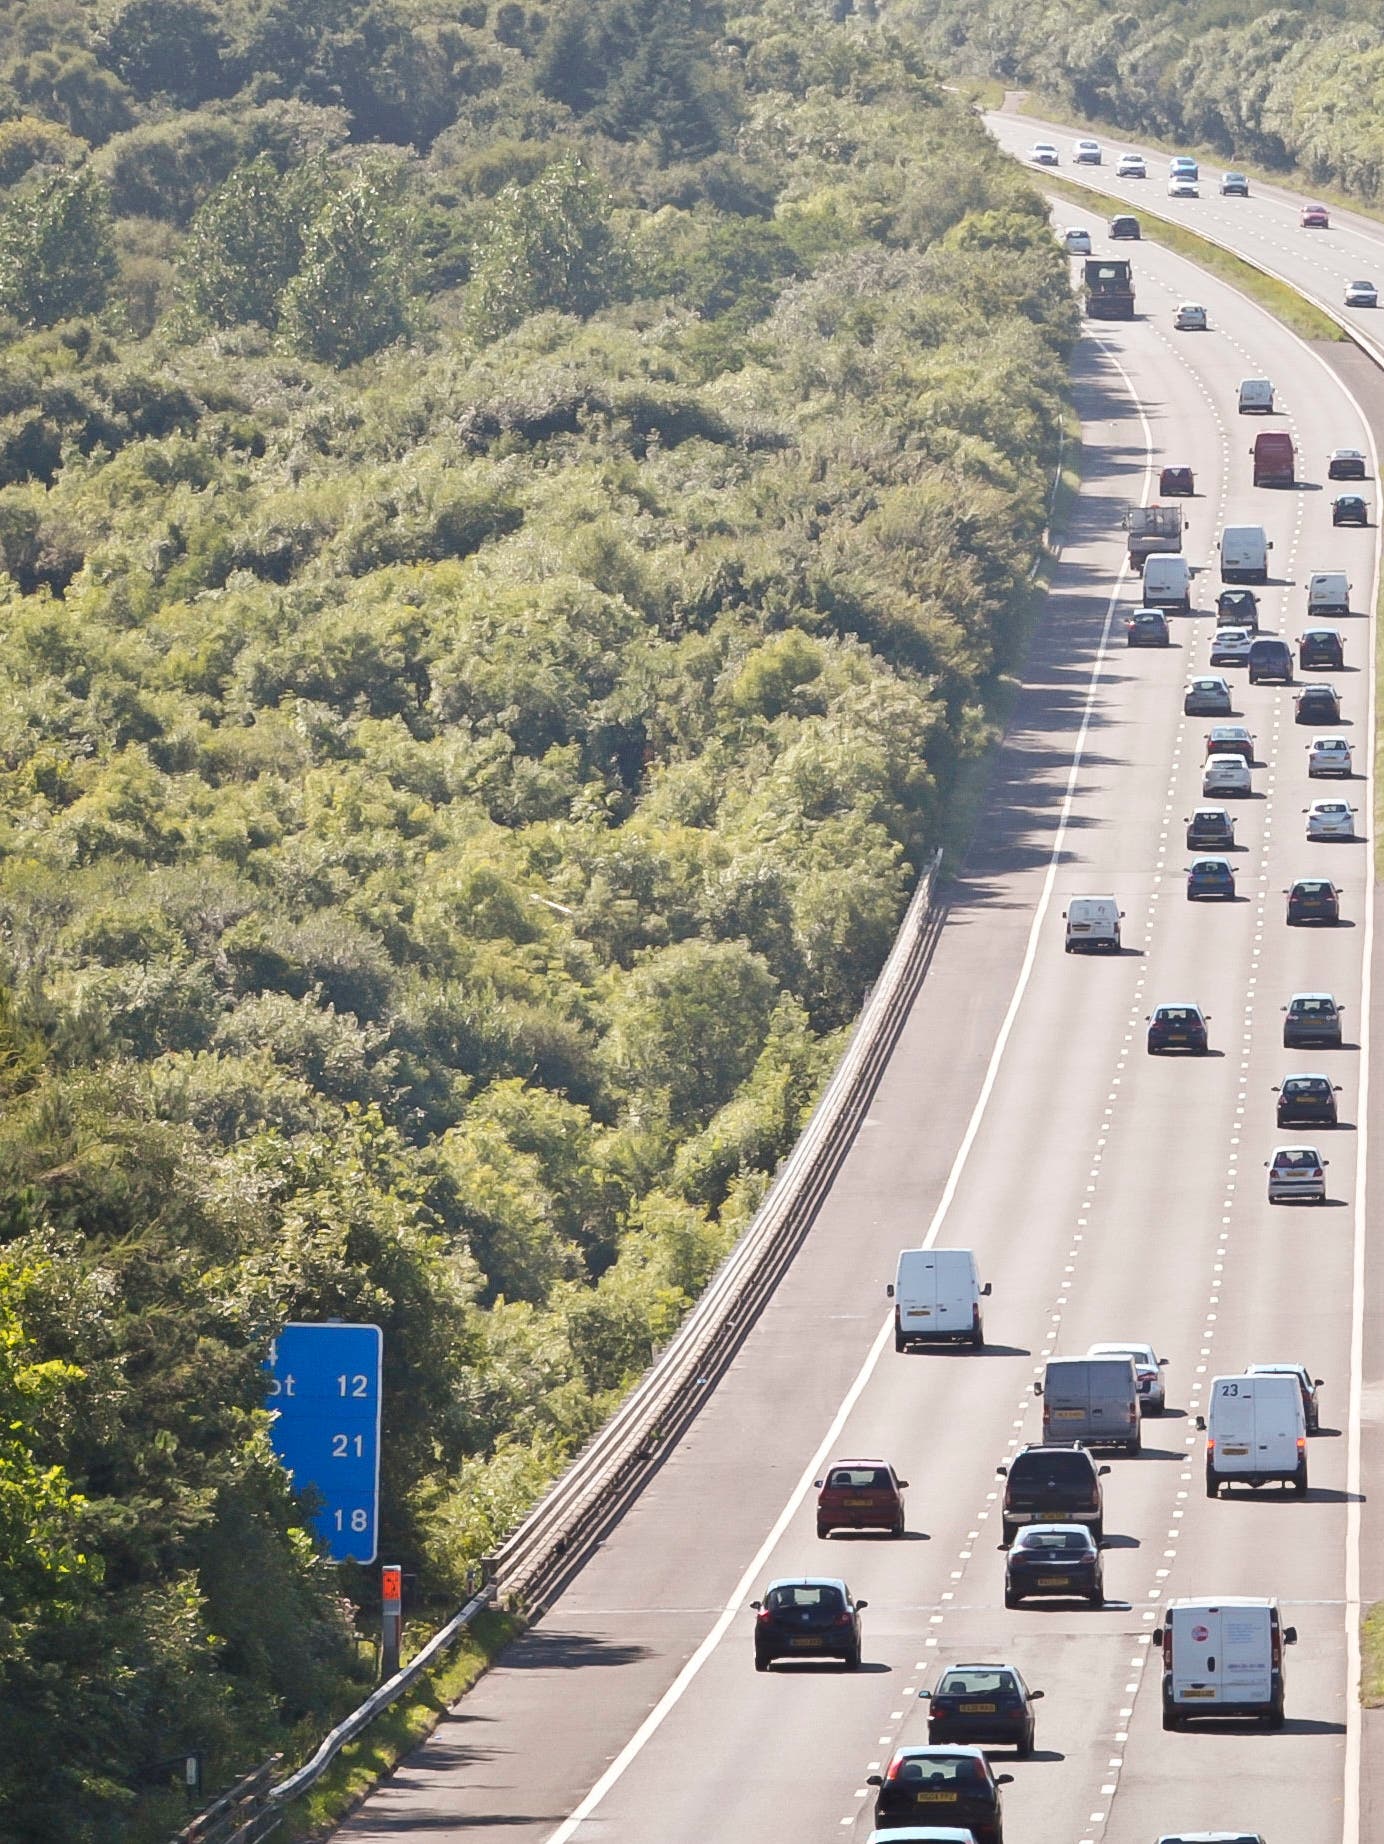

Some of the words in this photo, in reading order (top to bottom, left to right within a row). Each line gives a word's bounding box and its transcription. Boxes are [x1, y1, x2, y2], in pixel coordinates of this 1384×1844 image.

[267, 1374, 296, 1397] ot
[338, 1374, 368, 1397] 12
[1222, 1384, 1239, 1397] 23
[332, 1434, 362, 1457] 21
[334, 1509, 368, 1532] 18
